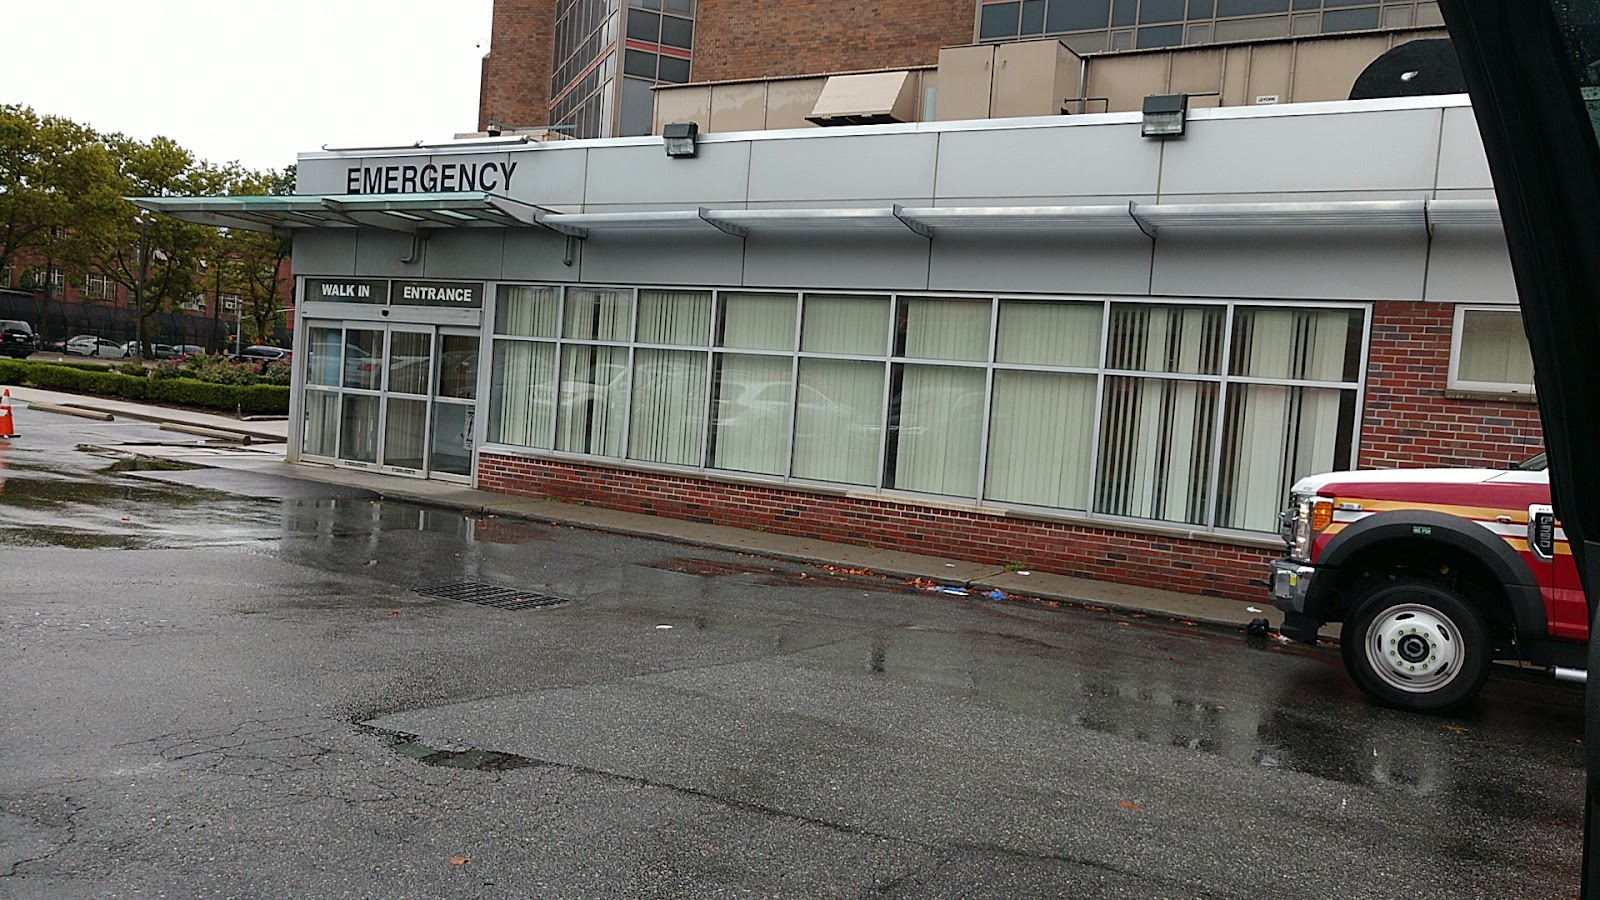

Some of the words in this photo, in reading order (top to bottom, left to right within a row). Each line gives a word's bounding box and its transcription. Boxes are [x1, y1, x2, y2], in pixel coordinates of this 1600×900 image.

[347, 162, 518, 194] EMERGENCY
[321, 283, 355, 297] WALK
[358, 285, 370, 297] IN
[403, 286, 472, 302] ENTRANCE
